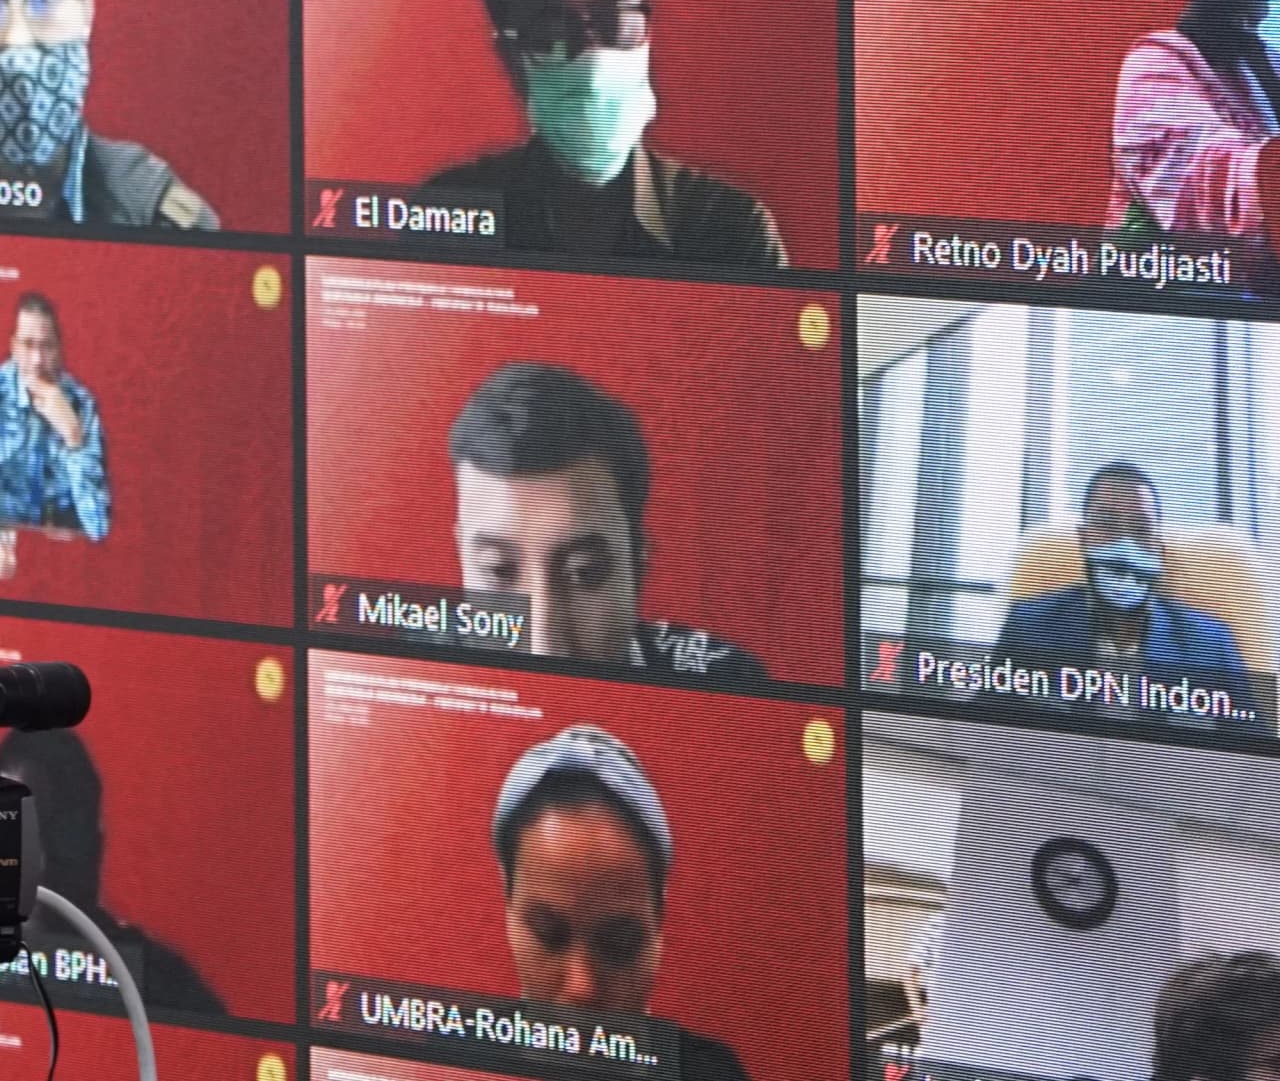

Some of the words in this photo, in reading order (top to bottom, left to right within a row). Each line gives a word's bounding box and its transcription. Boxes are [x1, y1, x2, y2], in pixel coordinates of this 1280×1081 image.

[355, 195, 380, 229] El
[387, 198, 497, 236] Damara
[912, 231, 1003, 268] Retno
[1012, 237, 1088, 281] Dyah
[1099, 242, 1231, 289] Pudjiasti
[357, 591, 448, 633] Mikael
[455, 599, 524, 648] Sony
[917, 651, 1051, 697] Presiden
[1059, 666, 1129, 707] DPN
[1138, 675, 1257, 722] Indon...
[360, 990, 581, 1056] UMBRA-Rohana
[588, 1024, 658, 1066] Am...
